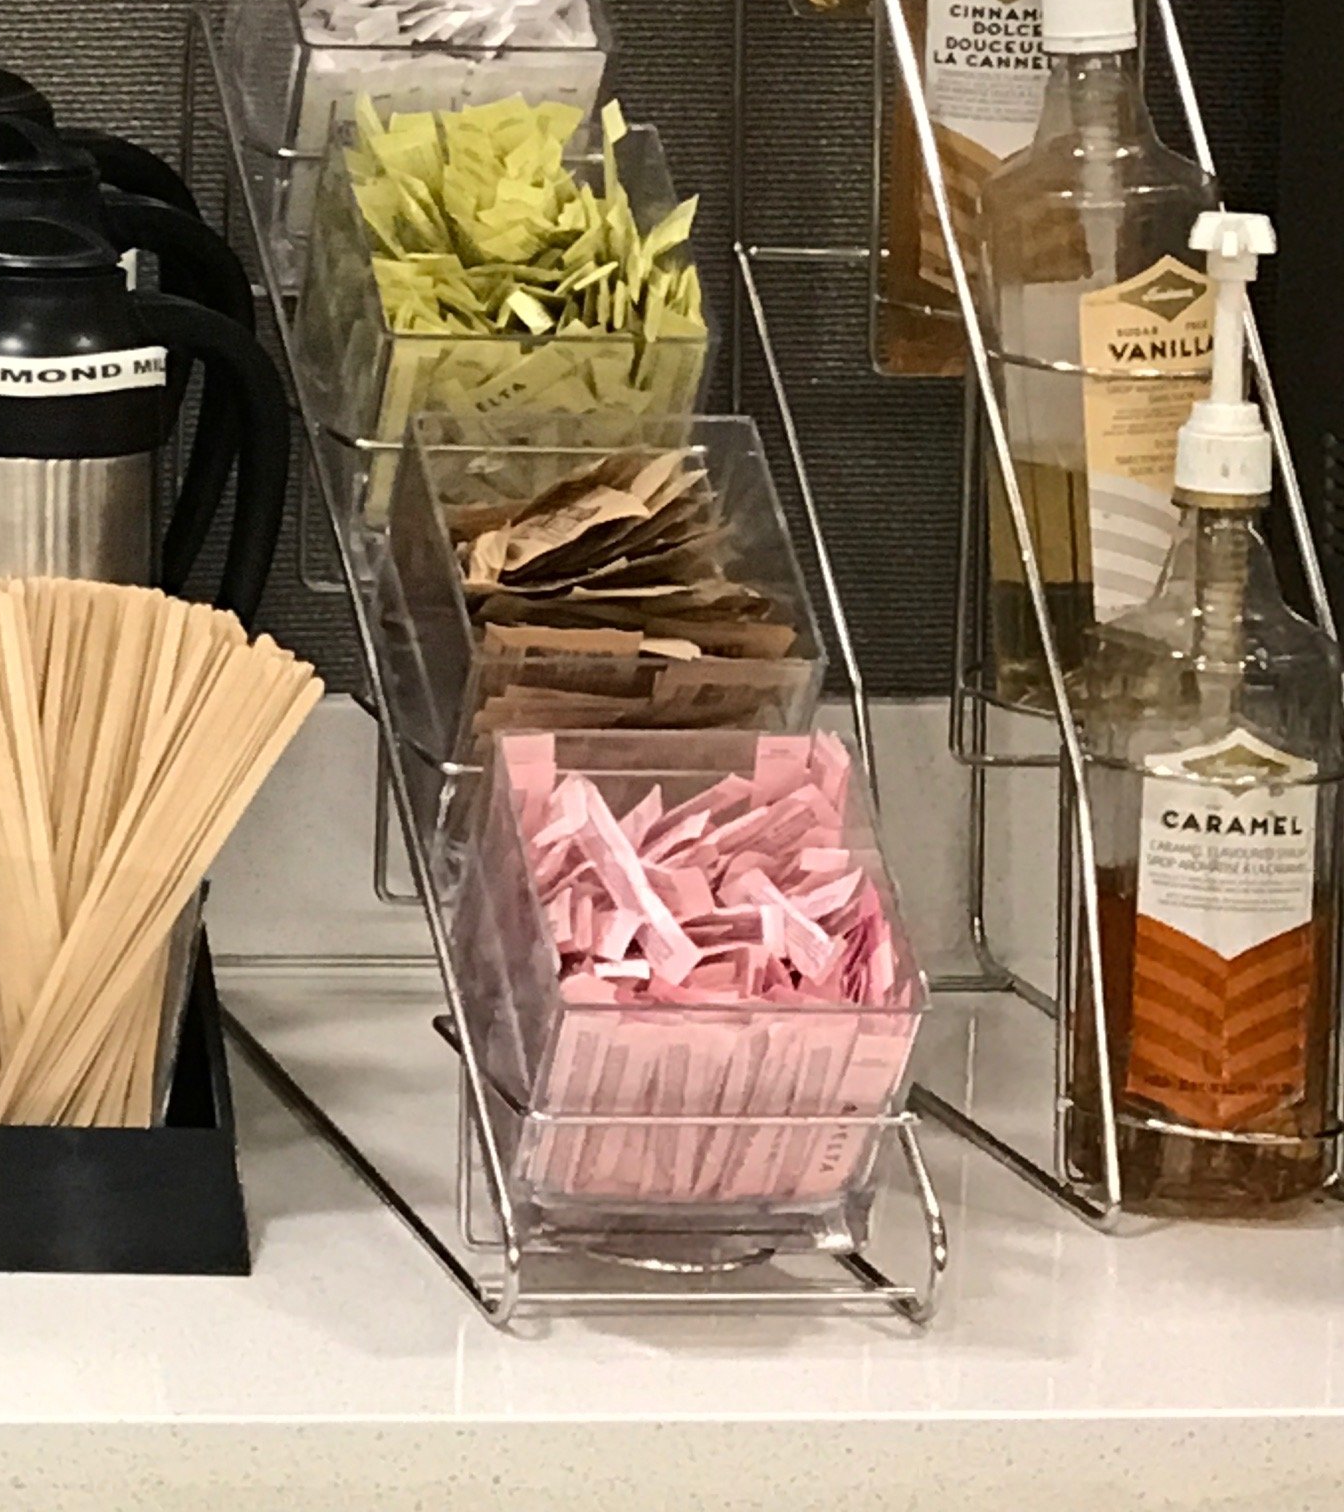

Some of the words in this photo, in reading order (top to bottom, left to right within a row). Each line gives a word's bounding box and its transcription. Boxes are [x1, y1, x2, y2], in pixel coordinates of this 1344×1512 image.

[950, 4, 1043, 22] CINNAM
[973, 21, 1043, 37] DOLCE
[933, 49, 958, 65] LA
[133, 359, 166, 375] MIL
[475, 382, 527, 413] ELTA
[1161, 810, 1303, 836] CARAMEL
[819, 1124, 848, 1172] ELTA
